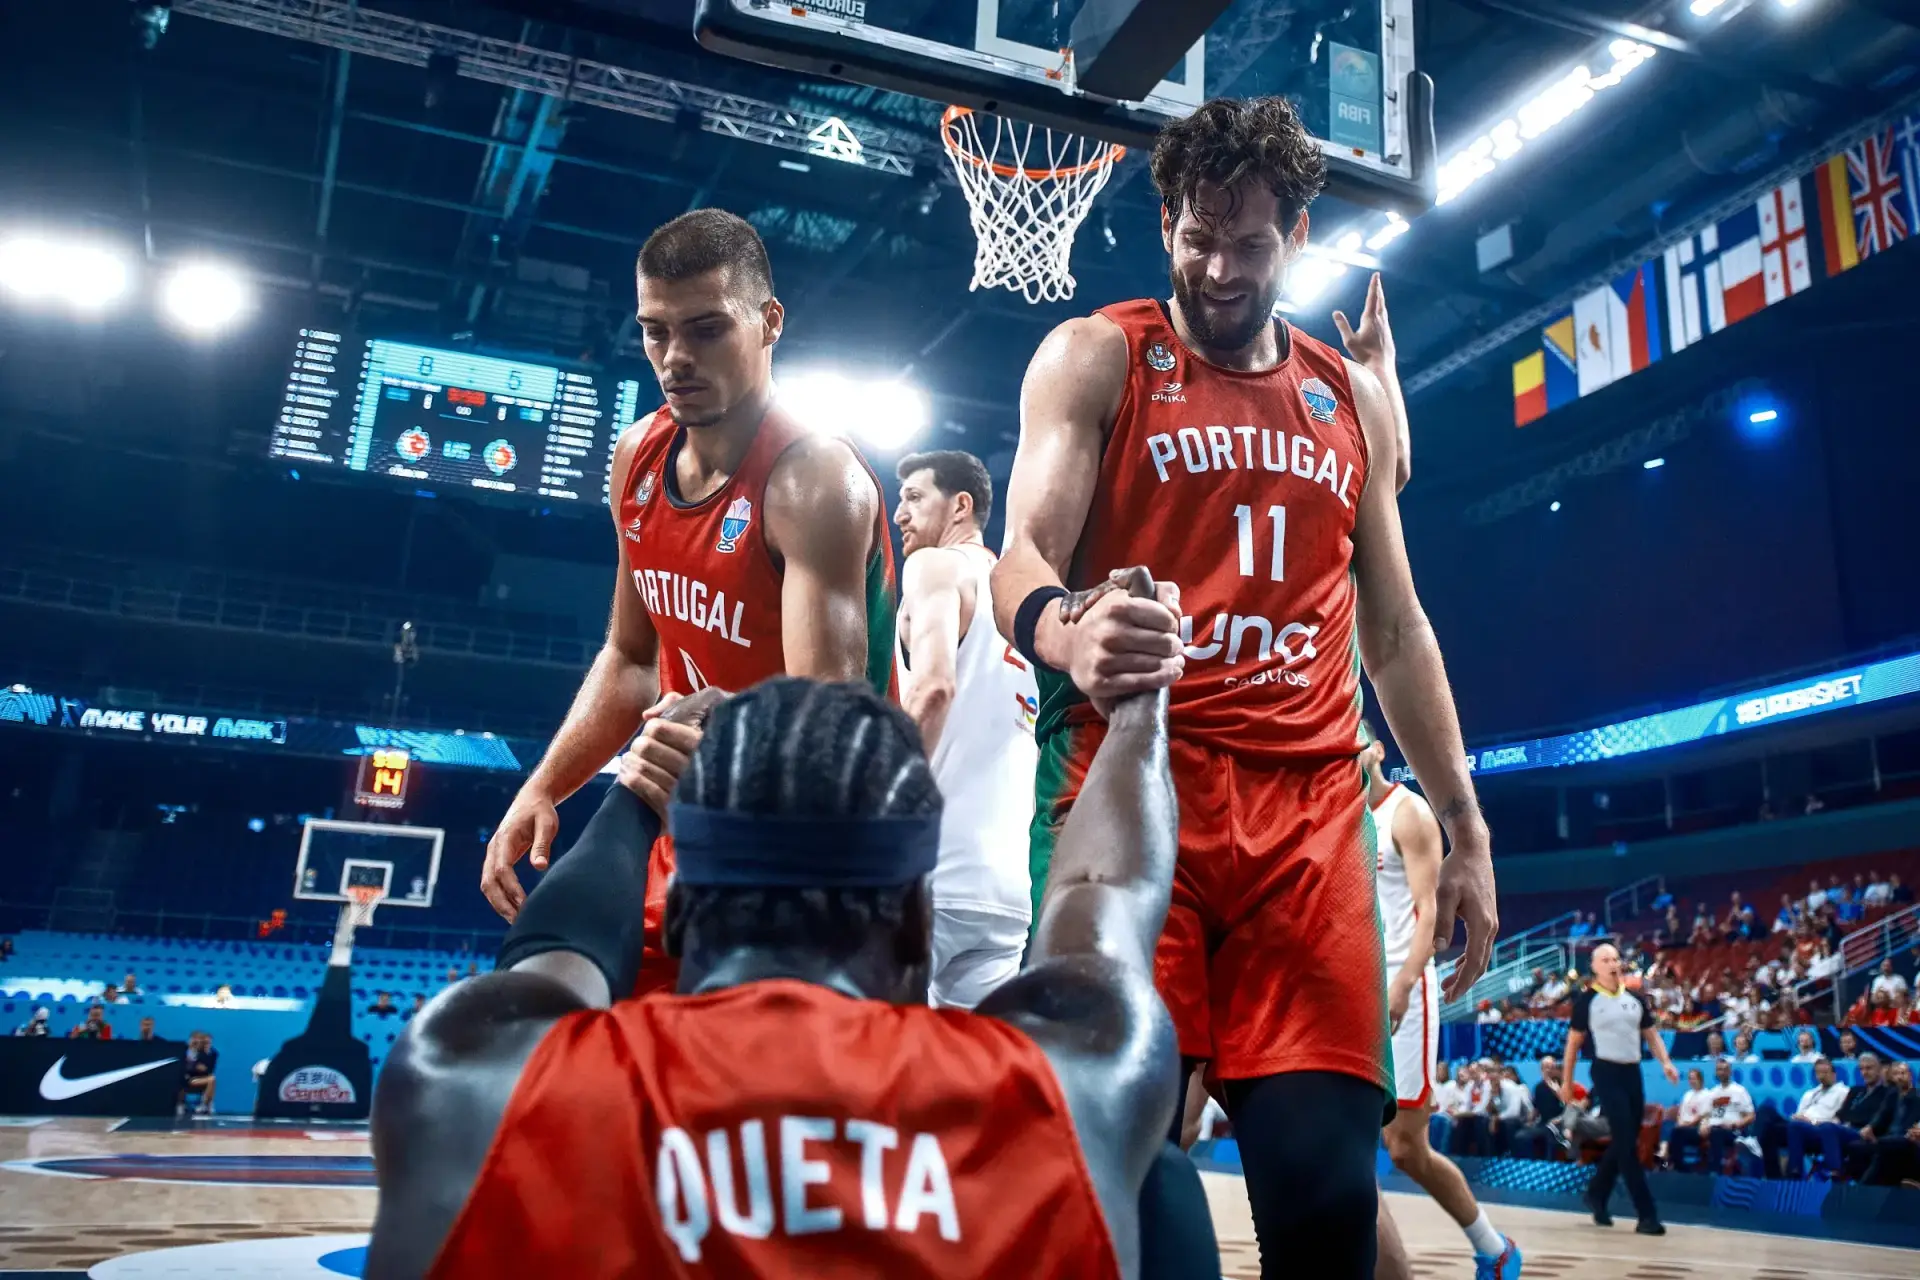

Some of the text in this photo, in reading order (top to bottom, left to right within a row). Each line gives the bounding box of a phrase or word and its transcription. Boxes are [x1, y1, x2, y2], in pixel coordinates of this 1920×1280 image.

[1147, 426, 1353, 508] PORTUGAL
[1233, 504, 1286, 582] 11
[633, 569, 751, 648] ORTUGAL
[1180, 612, 1320, 665] una
[80, 708, 146, 731] MAKE
[151, 712, 209, 735] YOUR
[374, 768, 403, 795] 14
[656, 1114, 961, 1263] QUETA
